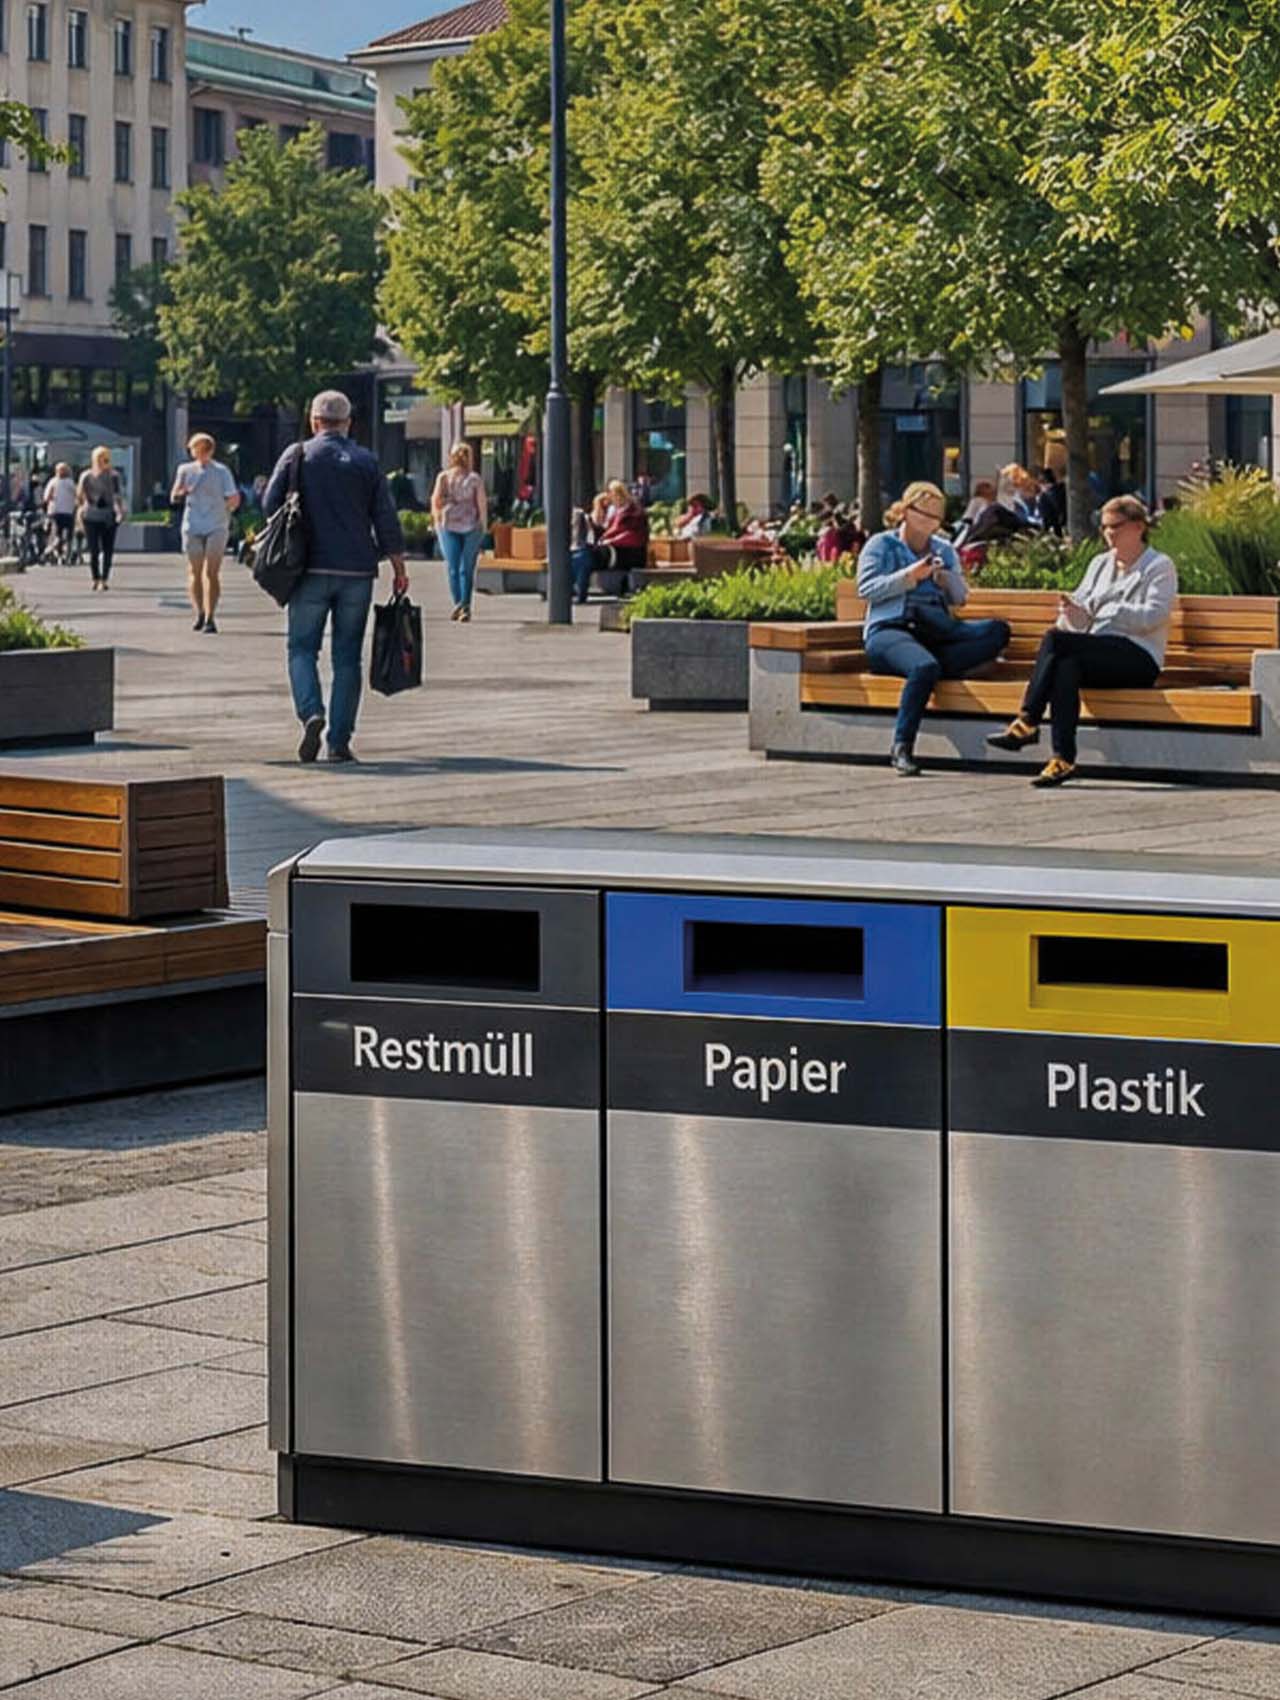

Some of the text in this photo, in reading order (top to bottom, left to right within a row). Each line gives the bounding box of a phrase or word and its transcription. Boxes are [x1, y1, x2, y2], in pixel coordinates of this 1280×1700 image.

[353, 1024, 534, 1078] Restmüll
[704, 1043, 848, 1103] Papier
[1047, 1062, 1206, 1118] Plastik
